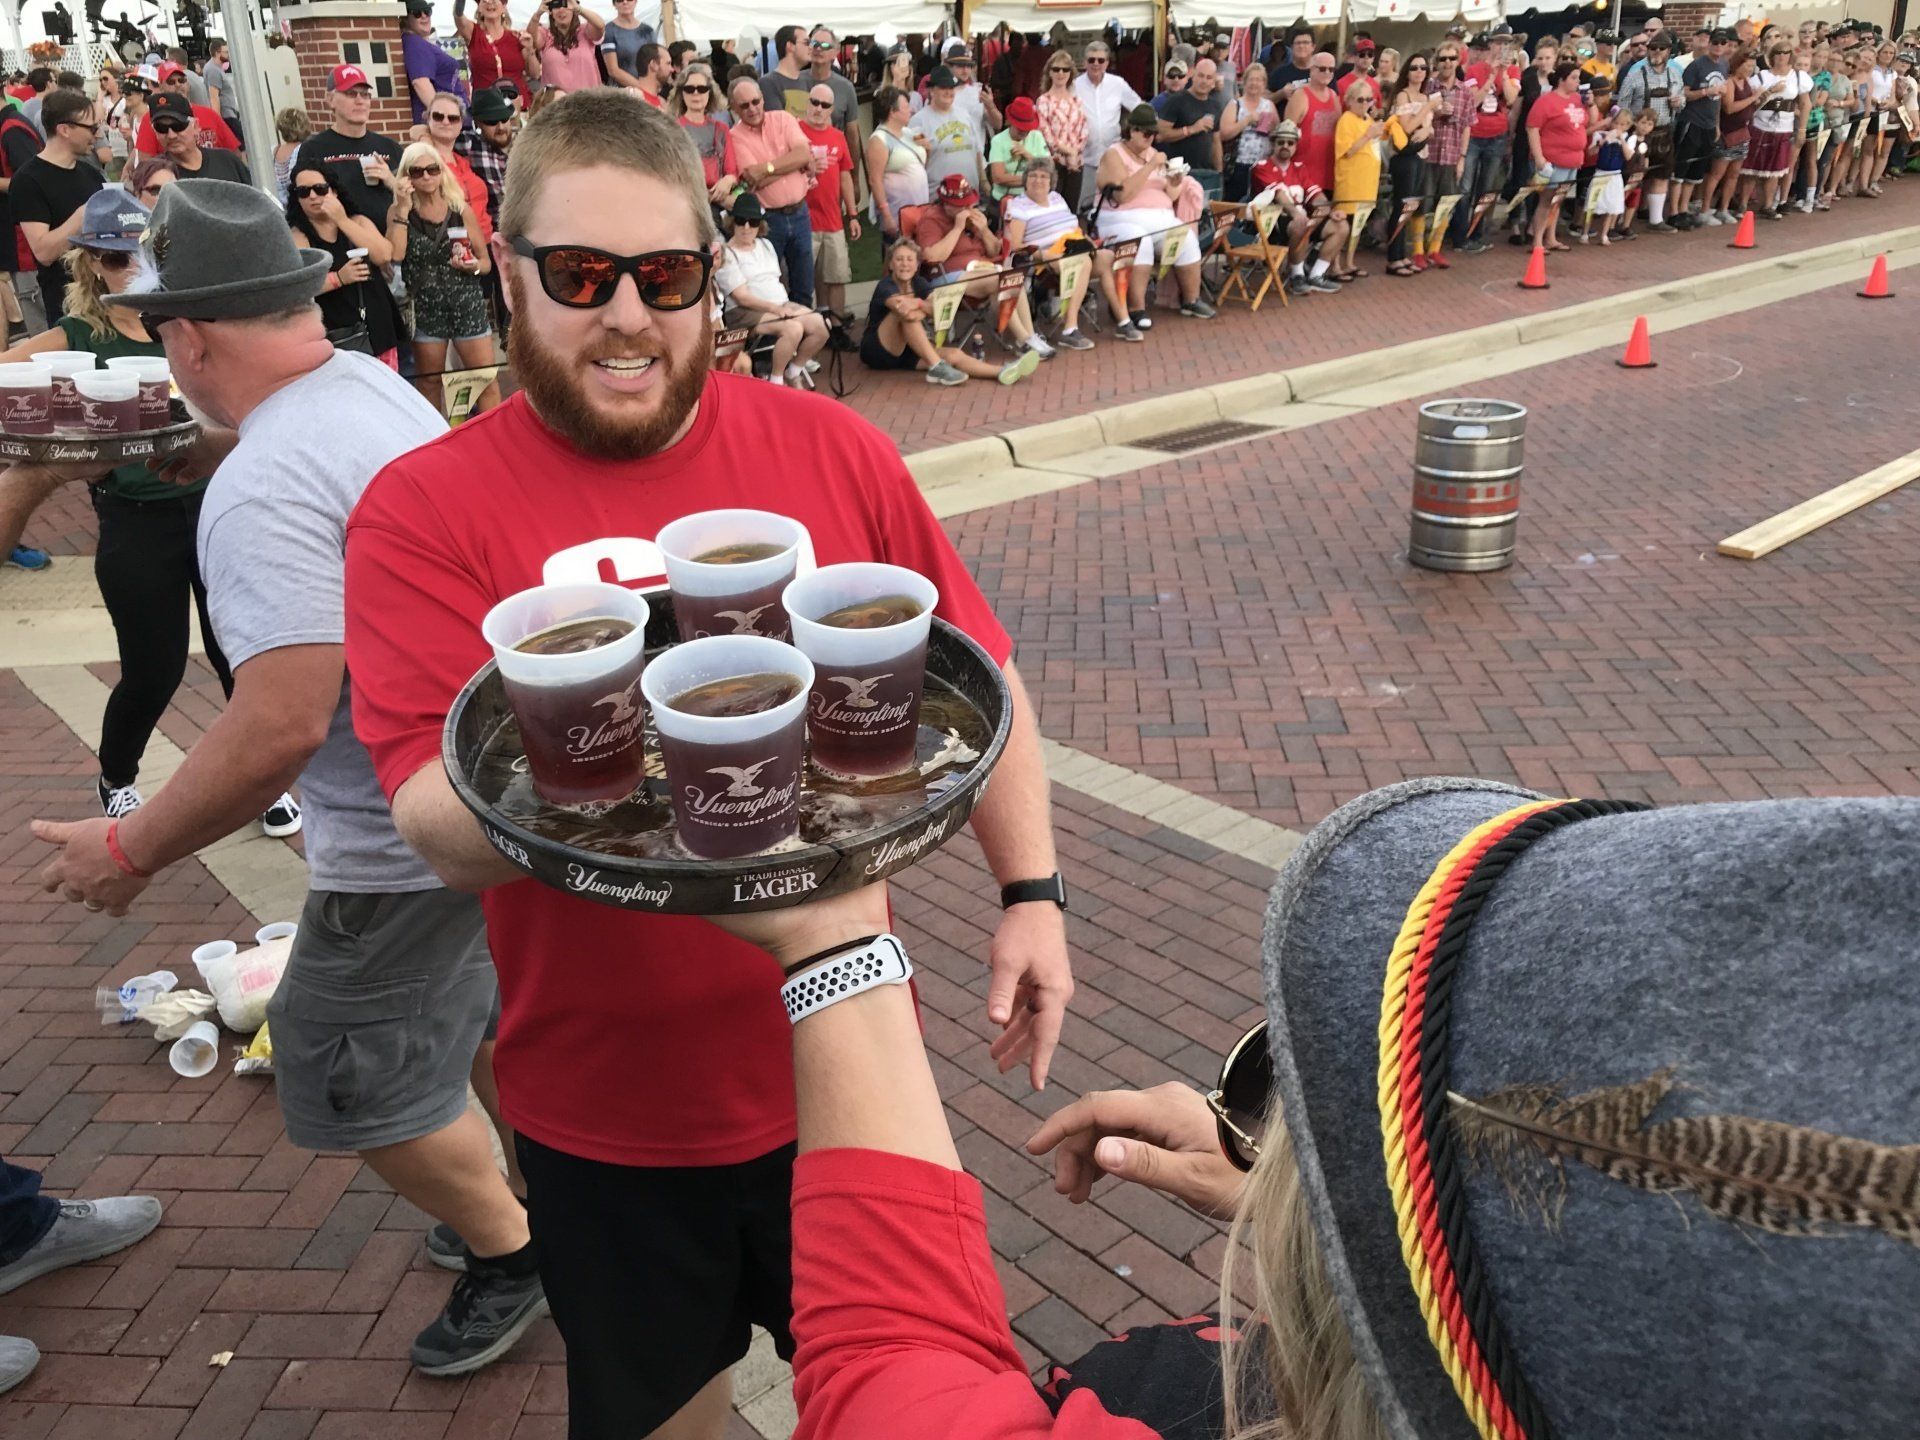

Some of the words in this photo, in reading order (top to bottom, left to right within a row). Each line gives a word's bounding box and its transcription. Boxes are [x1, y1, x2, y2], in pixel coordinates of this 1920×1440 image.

[717, 330, 749, 344] LAGER
[2, 405, 49, 419] Yuengling
[139, 398, 169, 410] uengling
[0, 444, 31, 457] LAGER
[50, 444, 99, 460] Yuengling
[122, 444, 154, 456] LAGER
[809, 691, 914, 728] Yuengling
[572, 750, 614, 763] AMERICA'S
[684, 771, 798, 818] Yuengling
[690, 815, 730, 827] AMERICA'S
[732, 817, 765, 828] OLDEST
[485, 823, 534, 870] LAGER
[864, 809, 950, 876] Yuengling
[742, 866, 809, 883] TRADITIONAL
[565, 862, 673, 908] Yuengling
[733, 871, 819, 903] LAGER
